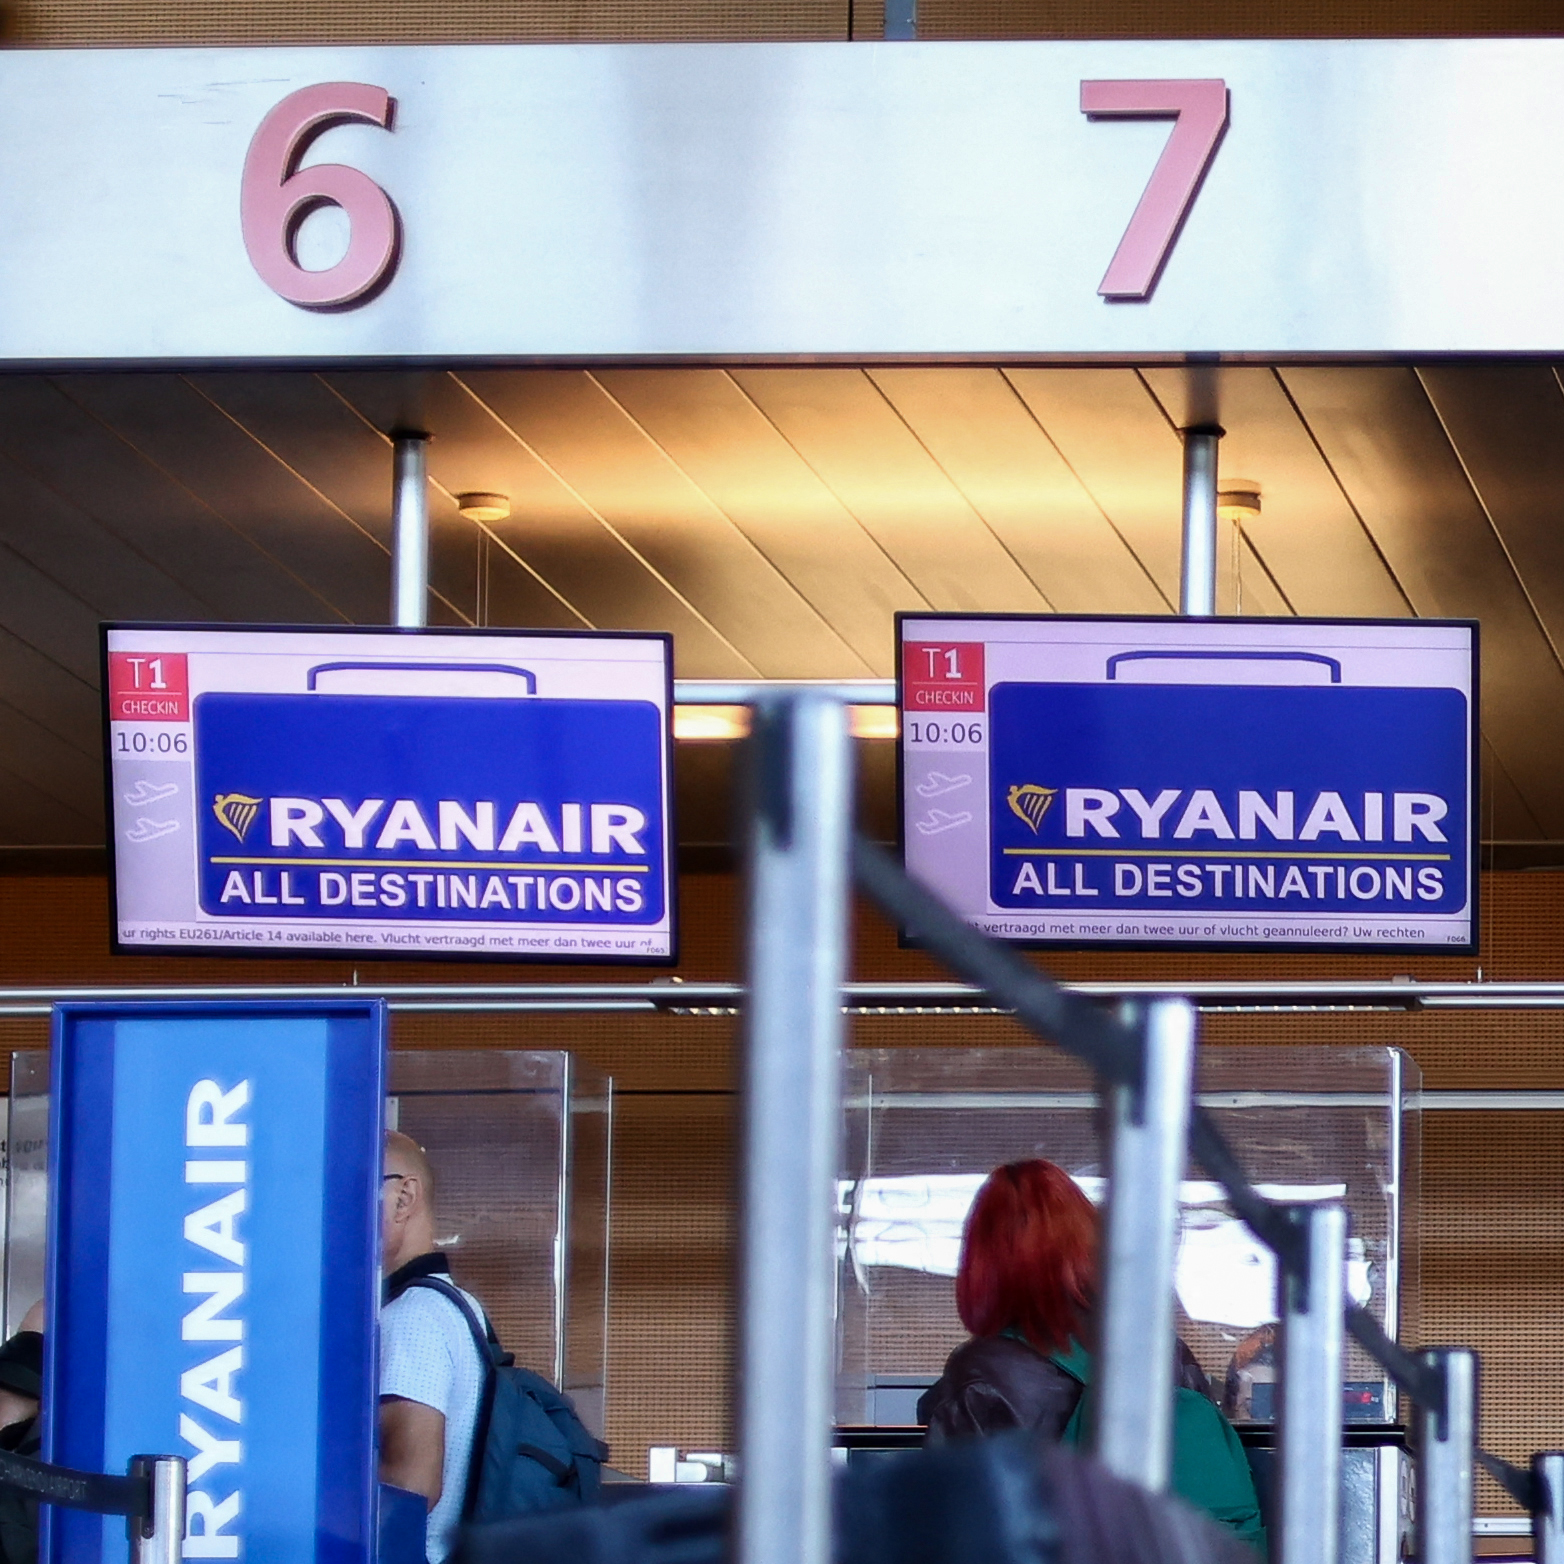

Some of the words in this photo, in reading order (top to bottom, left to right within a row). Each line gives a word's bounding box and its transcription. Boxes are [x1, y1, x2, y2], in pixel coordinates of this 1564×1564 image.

[241, 81, 400, 309] 6
[1080, 79, 1230, 302] 7
[126, 658, 167, 689] T1
[922, 648, 962, 679] T1
[121, 700, 179, 715] CHECKIN
[915, 690, 974, 705] CHECKIN
[117, 732, 188, 753] 10:06
[910, 722, 983, 744] 10:06
[270, 797, 647, 855] RYANAIR
[1065, 788, 1449, 843] RYANAIR
[220, 871, 305, 905] ALL
[319, 873, 642, 912] DESTINATIONS
[1012, 862, 1099, 896] ALL
[1115, 863, 1444, 901] DESTINATIONS
[140, 928, 176, 941] rights
[179, 928, 263, 942] EU261/Article
[267, 930, 282, 941] 14
[286, 930, 342, 943] available
[345, 931, 377, 943] here.
[381, 932, 421, 944] Vlucht
[424, 934, 485, 948] vertraagd
[489, 936, 514, 946] met
[518, 937, 550, 947] meer
[553, 936, 578, 948] dan
[581, 938, 612, 948] twee
[615, 939, 635, 949] uur
[984, 922, 1046, 936] vertraagd
[1050, 924, 1075, 934] met
[1079, 925, 1112, 934] meer
[1116, 924, 1140, 935] dan
[1144, 924, 1174, 935] twee
[1178, 926, 1199, 936] uur
[1204, 924, 1216, 936] of
[1220, 924, 1258, 936] vlucht
[1263, 926, 1348, 939] geannuleerd?
[1353, 926, 1372, 938] Uw
[1376, 927, 1425, 938] rechten
[180, 1078, 249, 1559] RYANAIR
